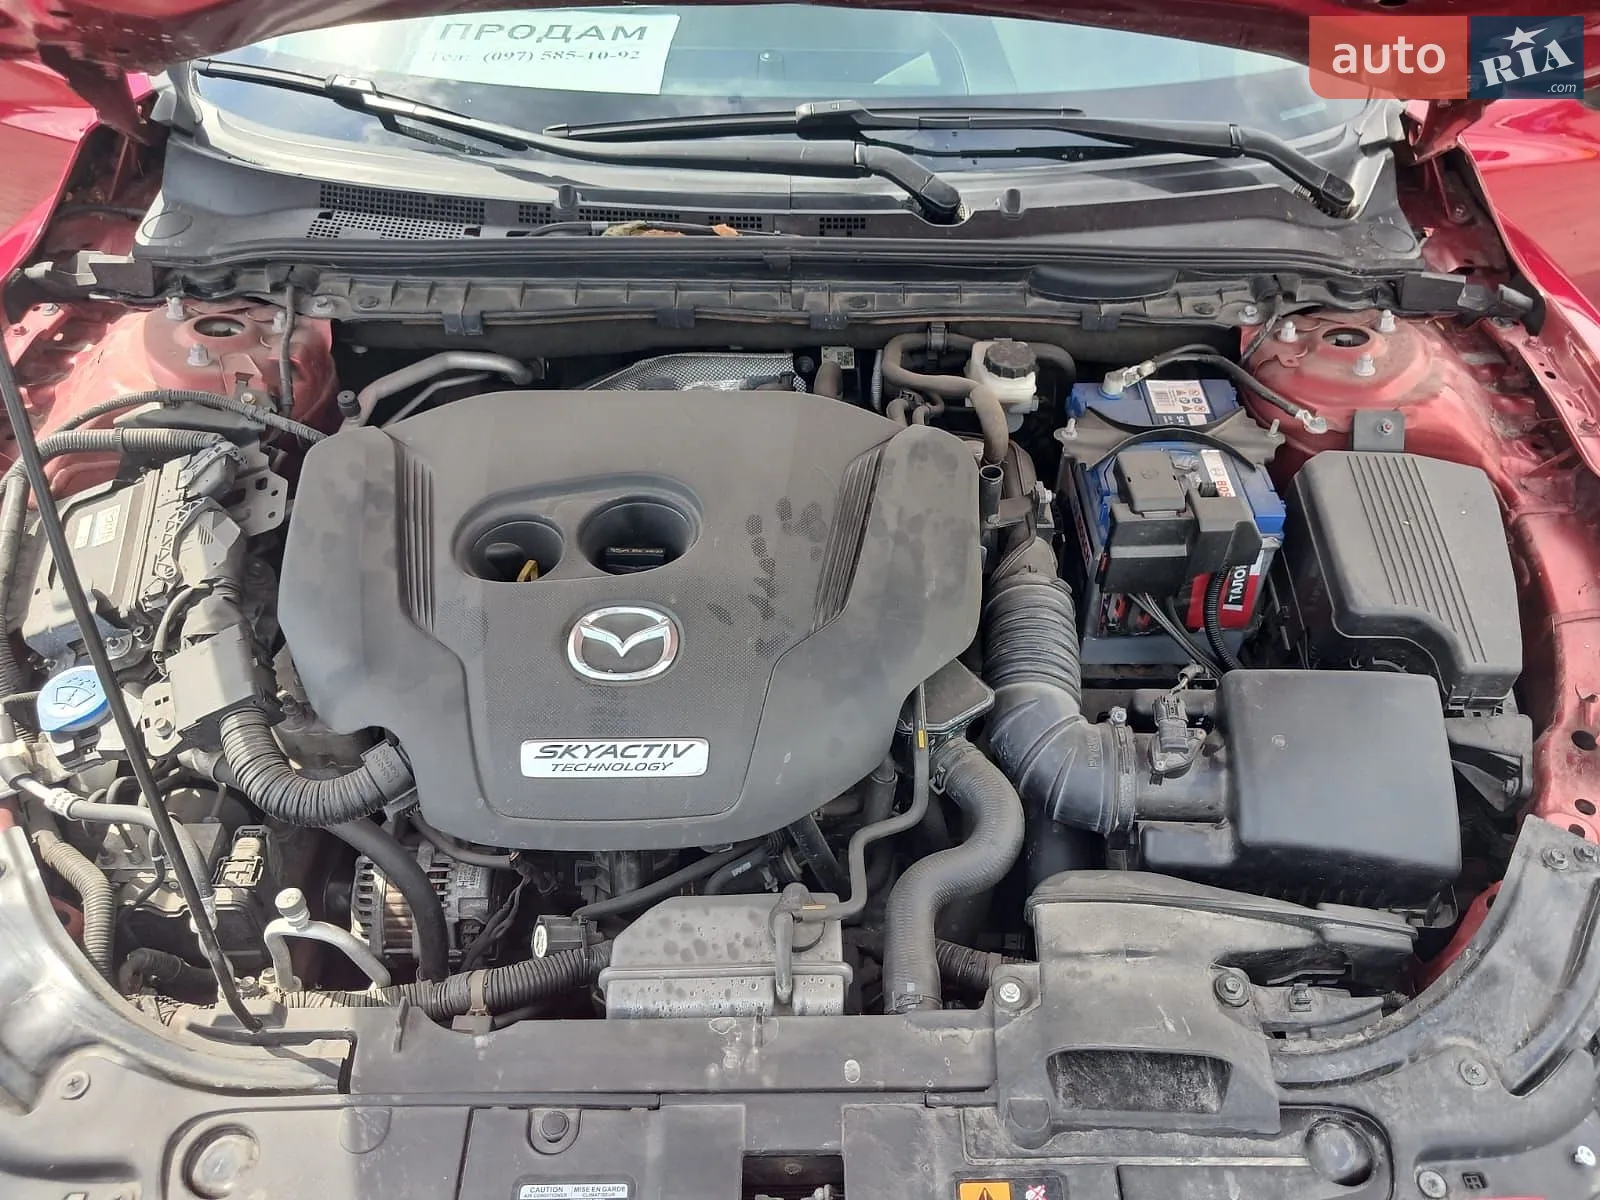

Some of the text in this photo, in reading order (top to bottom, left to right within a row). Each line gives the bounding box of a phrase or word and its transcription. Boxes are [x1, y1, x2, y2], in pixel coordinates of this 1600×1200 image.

[440, 23, 648, 43] ПРОДАМ
[482, 50, 534, 63] (097)
[540, 51, 641, 60] 585-10-92
[534, 743, 696, 759] SKYACTIV
[551, 762, 674, 772] TECHNOLOGY
